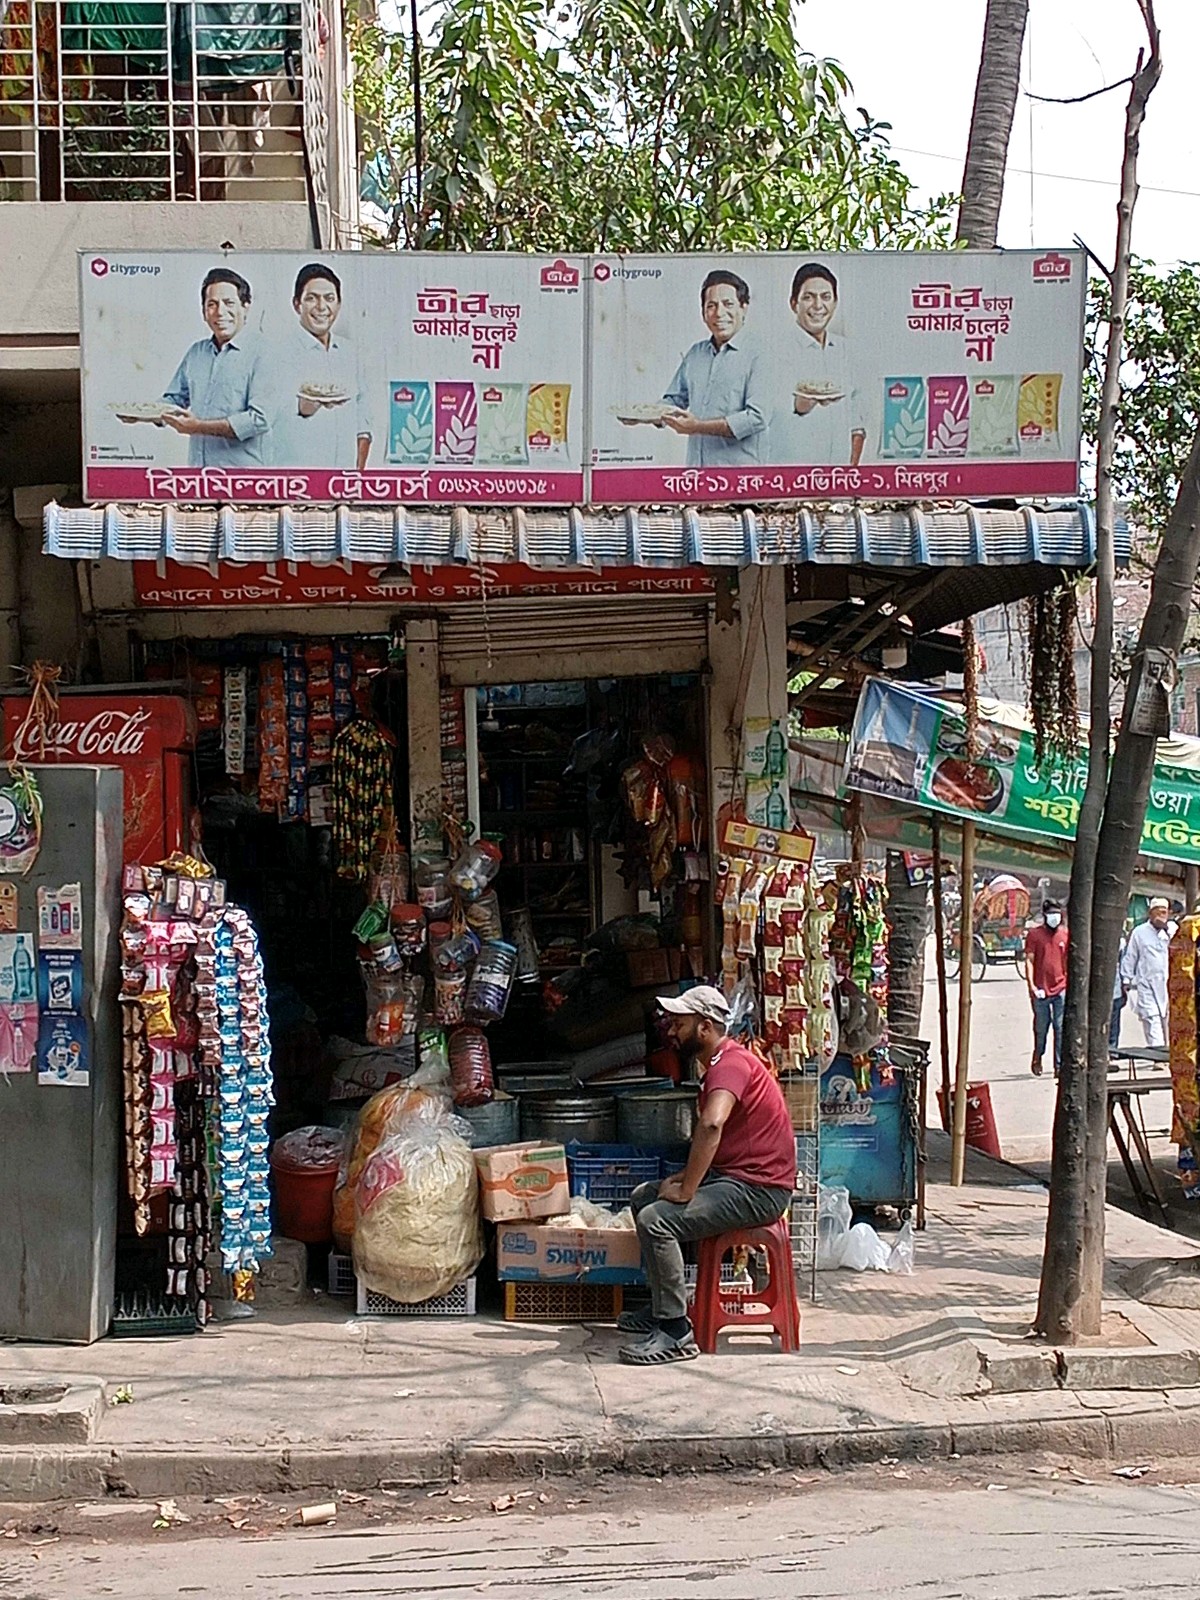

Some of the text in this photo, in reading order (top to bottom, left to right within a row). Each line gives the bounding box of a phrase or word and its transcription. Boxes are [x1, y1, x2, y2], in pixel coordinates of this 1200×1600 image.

[110, 263, 161, 276] citygroup
[546, 271, 575, 283] তীর
[612, 268, 662, 280] citygroup
[1039, 262, 1067, 274] তীর
[417, 288, 521, 321] তীর ছাড়া
[911, 284, 1013, 314] তীর ছাড়া
[412, 318, 518, 343] আমার চলেই
[907, 313, 1011, 335] আমার চলেই
[472, 342, 503, 370] না
[965, 335, 995, 362] না
[328, 470, 433, 499] ট্রেডার্স
[894, 466, 949, 493] মিরপুর
[141, 587, 212, 602] এখানে
[365, 584, 419, 598] আটা
[427, 585, 446, 597] ও
[520, 582, 559, 595] কম
[628, 577, 695, 591] পাওয়া
[12, 709, 153, 756] Coca-Cola
[547, 1249, 607, 1265] MARKS
